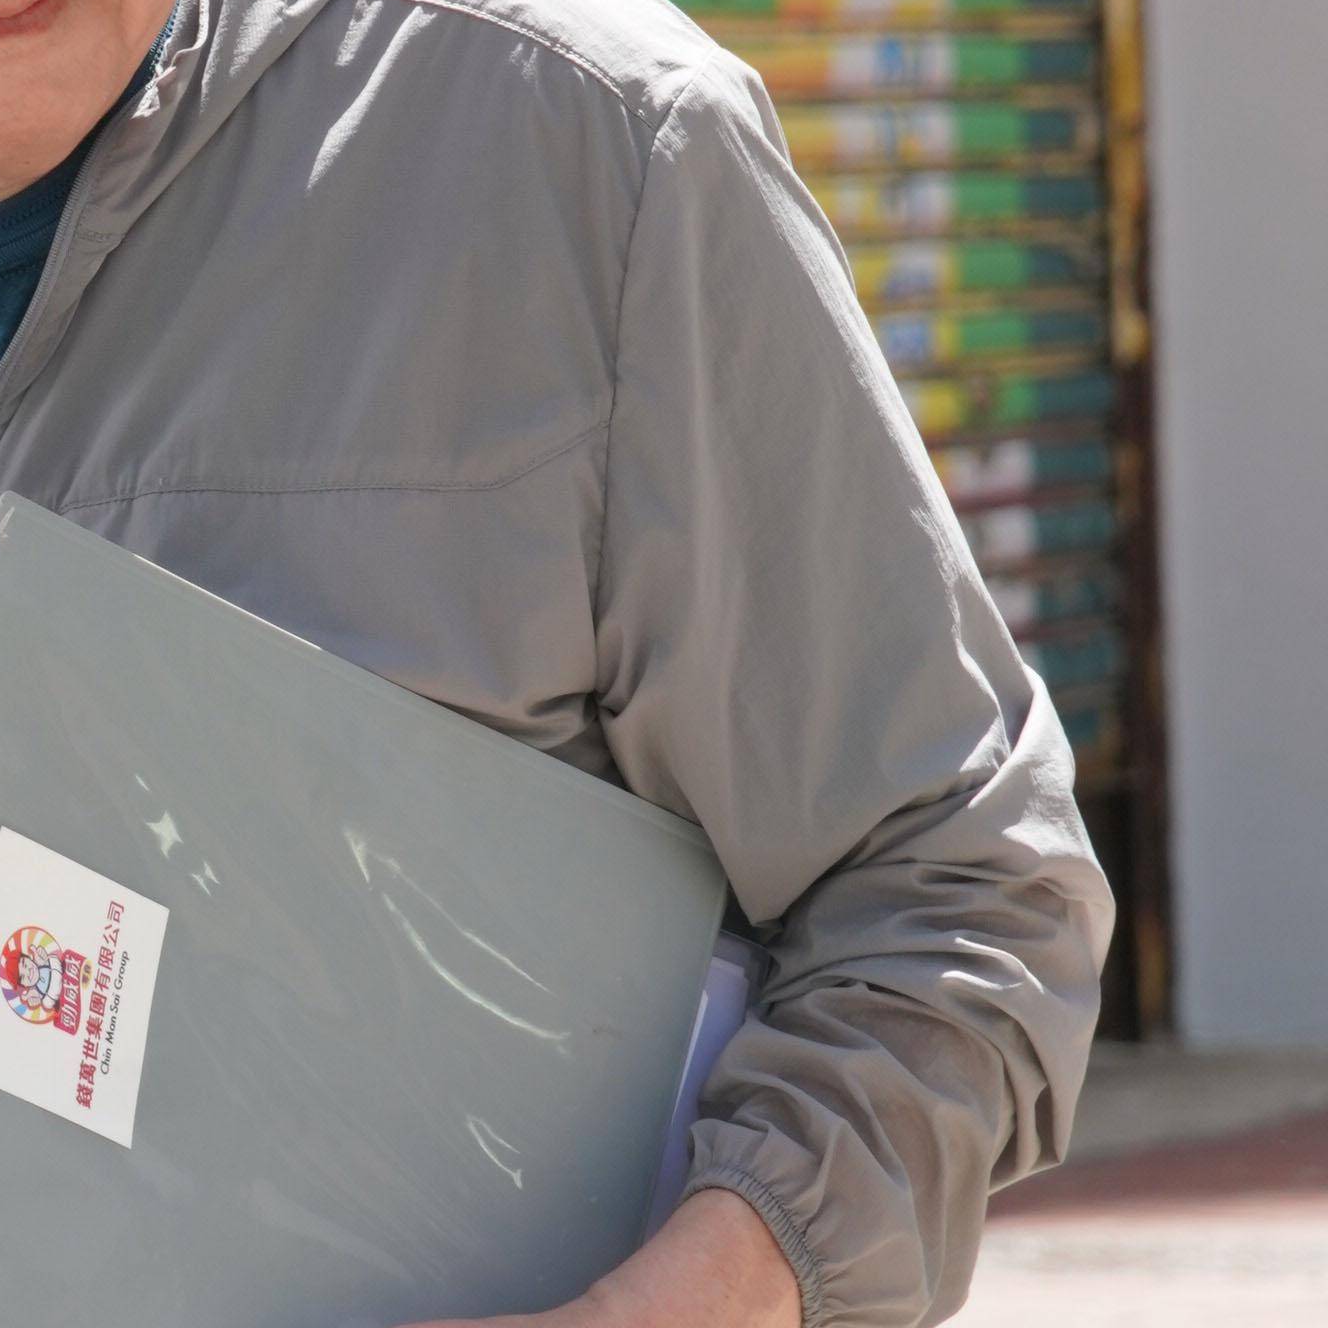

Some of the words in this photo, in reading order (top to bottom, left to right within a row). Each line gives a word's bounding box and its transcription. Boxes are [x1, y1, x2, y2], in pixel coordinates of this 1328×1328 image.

[114, 950, 130, 991] Group
[76, 900, 124, 1108] 錢萬世集團有限公司
[109, 992, 121, 1013] Sai
[99, 1047, 113, 1075] Chin
